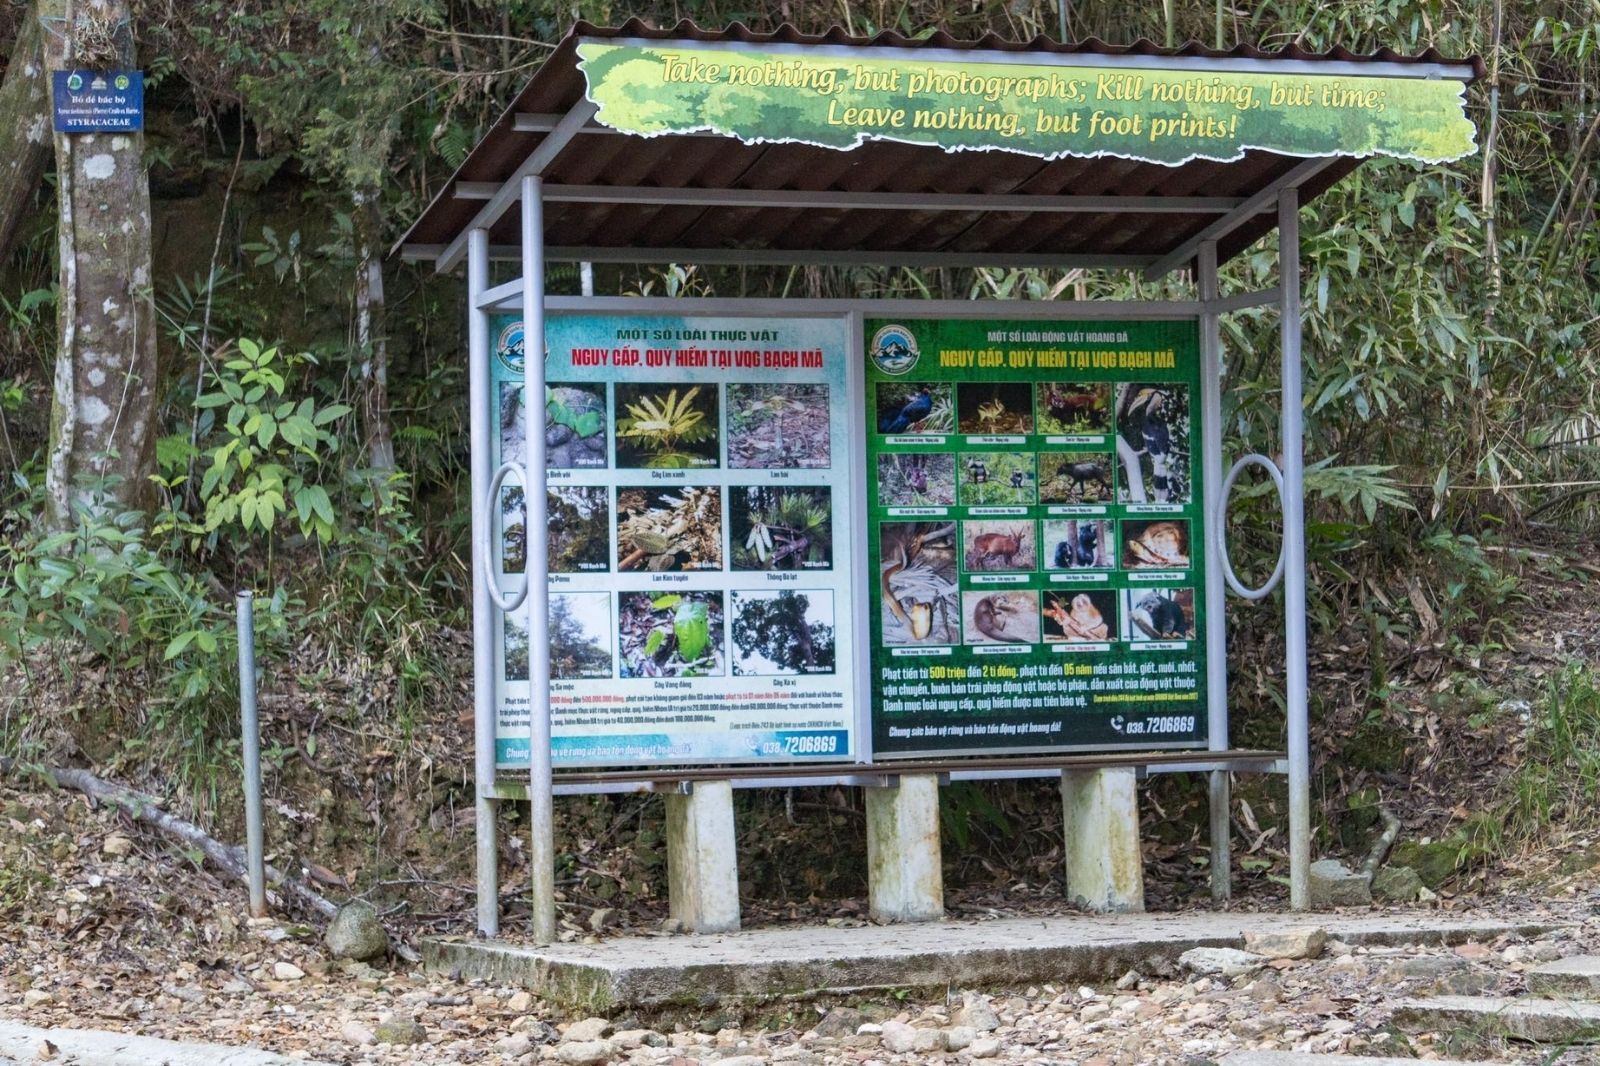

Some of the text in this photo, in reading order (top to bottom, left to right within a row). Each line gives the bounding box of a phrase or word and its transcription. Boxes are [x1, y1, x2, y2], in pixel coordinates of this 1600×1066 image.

[661, 55, 1387, 113] Take nothing, but photographs; Kill nothing, but time;
[67, 118, 131, 126] STYRACACEAE
[827, 99, 1238, 142] Leave nothing, but foot prints!
[571, 348, 608, 367] NGUY
[645, 346, 673, 368] QUÝ
[675, 345, 708, 368] HIẾM
[710, 350, 731, 370] TẠI
[735, 350, 761, 369] VQG
[764, 351, 798, 371] BẠCH
[801, 348, 823, 369] MÃ
[940, 350, 975, 367] NGUY
[1009, 348, 1035, 369] QUÝ
[1037, 346, 1067, 367] HIẾM
[1069, 351, 1089, 371] TẠI
[1092, 351, 1117, 369] VQG
[1119, 351, 1152, 371] BẠCH
[1154, 349, 1175, 368] MÃ
[882, 668, 901, 681] Phạt
[902, 668, 919, 680] tiền
[920, 668, 928, 679] từ
[929, 666, 945, 679] 500
[947, 667, 966, 680] triệu
[967, 666, 982, 678] đến
[983, 665, 988, 677] 2
[1020, 665, 1038, 678] phạt
[1039, 665, 1048, 676] tù
[1049, 663, 1062, 676] đến
[1064, 663, 1074, 676] 05
[1075, 665, 1092, 675] năm
[1093, 663, 1107, 674] nếu
[1108, 663, 1122, 674] săn
[882, 684, 898, 697] vận
[931, 683, 950, 694] buôn
[951, 682, 966, 694] bán
[967, 682, 982, 693] trái
[983, 681, 1002, 694] phép
[1003, 680, 1022, 694] động
[1023, 680, 1036, 693] vật
[1038, 679, 1056, 693] hoặc
[1057, 679, 1066, 692] bộ
[1091, 677, 1105, 690] dẫn
[1106, 677, 1123, 690] xuất
[1124, 679, 1139, 689] của
[1140, 677, 1158, 691] động
[1159, 677, 1172, 690] vật
[1173, 676, 1195, 689] thuộc
[883, 699, 903, 711] Danh
[904, 701, 921, 713] mục
[922, 698, 937, 711] loài
[938, 700, 958, 712] nguy
[976, 699, 991, 711] quý
[992, 696, 1011, 708] hiếm
[1012, 696, 1031, 709] được
[1032, 696, 1042, 707] ưu
[1043, 695, 1059, 706] tiên
[1060, 694, 1074, 706] bảo
[1075, 695, 1087, 708] vệ.
[1126, 716, 1195, 734] 038.7206869
[763, 736, 836, 753] 038.7206869
